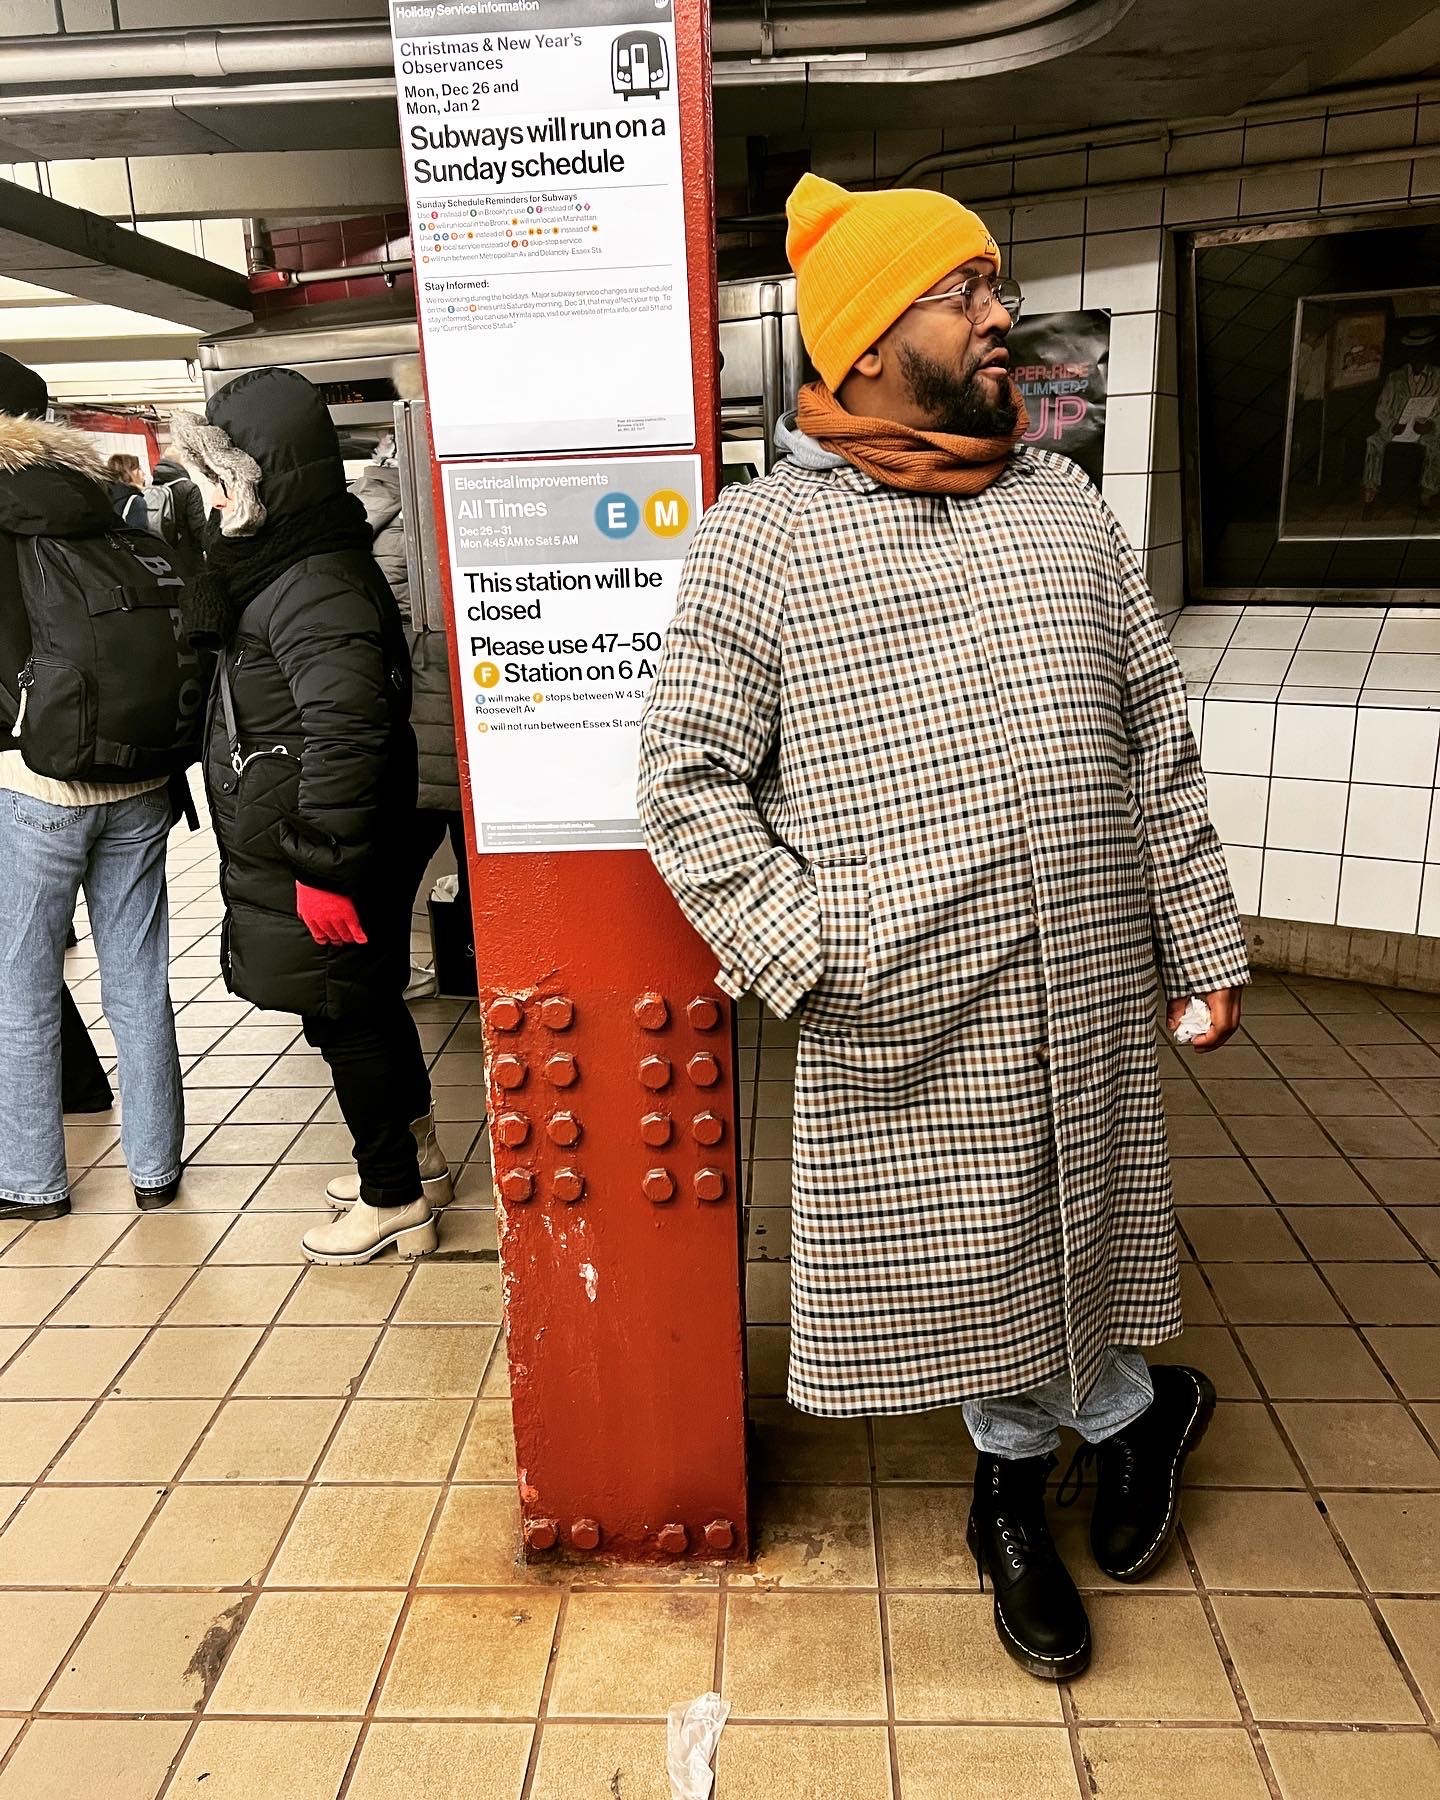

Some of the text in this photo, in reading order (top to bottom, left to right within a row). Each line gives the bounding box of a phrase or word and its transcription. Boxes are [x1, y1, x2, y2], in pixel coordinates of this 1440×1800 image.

[396, 0, 540, 18] Holiday Service Information
[400, 32, 582, 56] Christmas & New Year's
[402, 58, 504, 74] Observances
[405, 79, 519, 99] Mon, Dec 26 and
[406, 99, 480, 115] Mon, Jan 2
[411, 117, 666, 150] Subways will run on a
[414, 149, 625, 184] Sunday schedule
[416, 200, 446, 209] Sunday
[447, 198, 484, 207] Schedule
[485, 196, 529, 205] Reminders
[541, 193, 577, 202] Subways
[424, 280, 489, 292] Stay Informed:
[1016, 380, 1089, 396] NLIMITED?
[455, 473, 608, 490] Electrical improvements
[458, 499, 548, 519] All Times
[608, 500, 679, 528] E M
[460, 527, 479, 536] Dec
[460, 535, 578, 549] Mon 4:45 AM to Sat 5 AM
[464, 567, 662, 593] This station will be
[467, 599, 541, 621] closed
[471, 636, 544, 657] Please
[548, 638, 588, 655] use
[504, 662, 582, 683] Station
[587, 664, 615, 680] on
[618, 660, 633, 680] 6
[488, 694, 503, 702] will
[505, 694, 530, 702] make
[545, 693, 571, 702] stops
[573, 692, 613, 700] between
[615, 690, 625, 699] W
[626, 690, 632, 698] 4
[634, 690, 645, 698] St
[475, 705, 535, 714] Roosevelt Av
[490, 722, 506, 730] will
[507, 722, 522, 730] not
[541, 721, 582, 730] between
[583, 720, 610, 728] Essex
[612, 719, 622, 728] St
